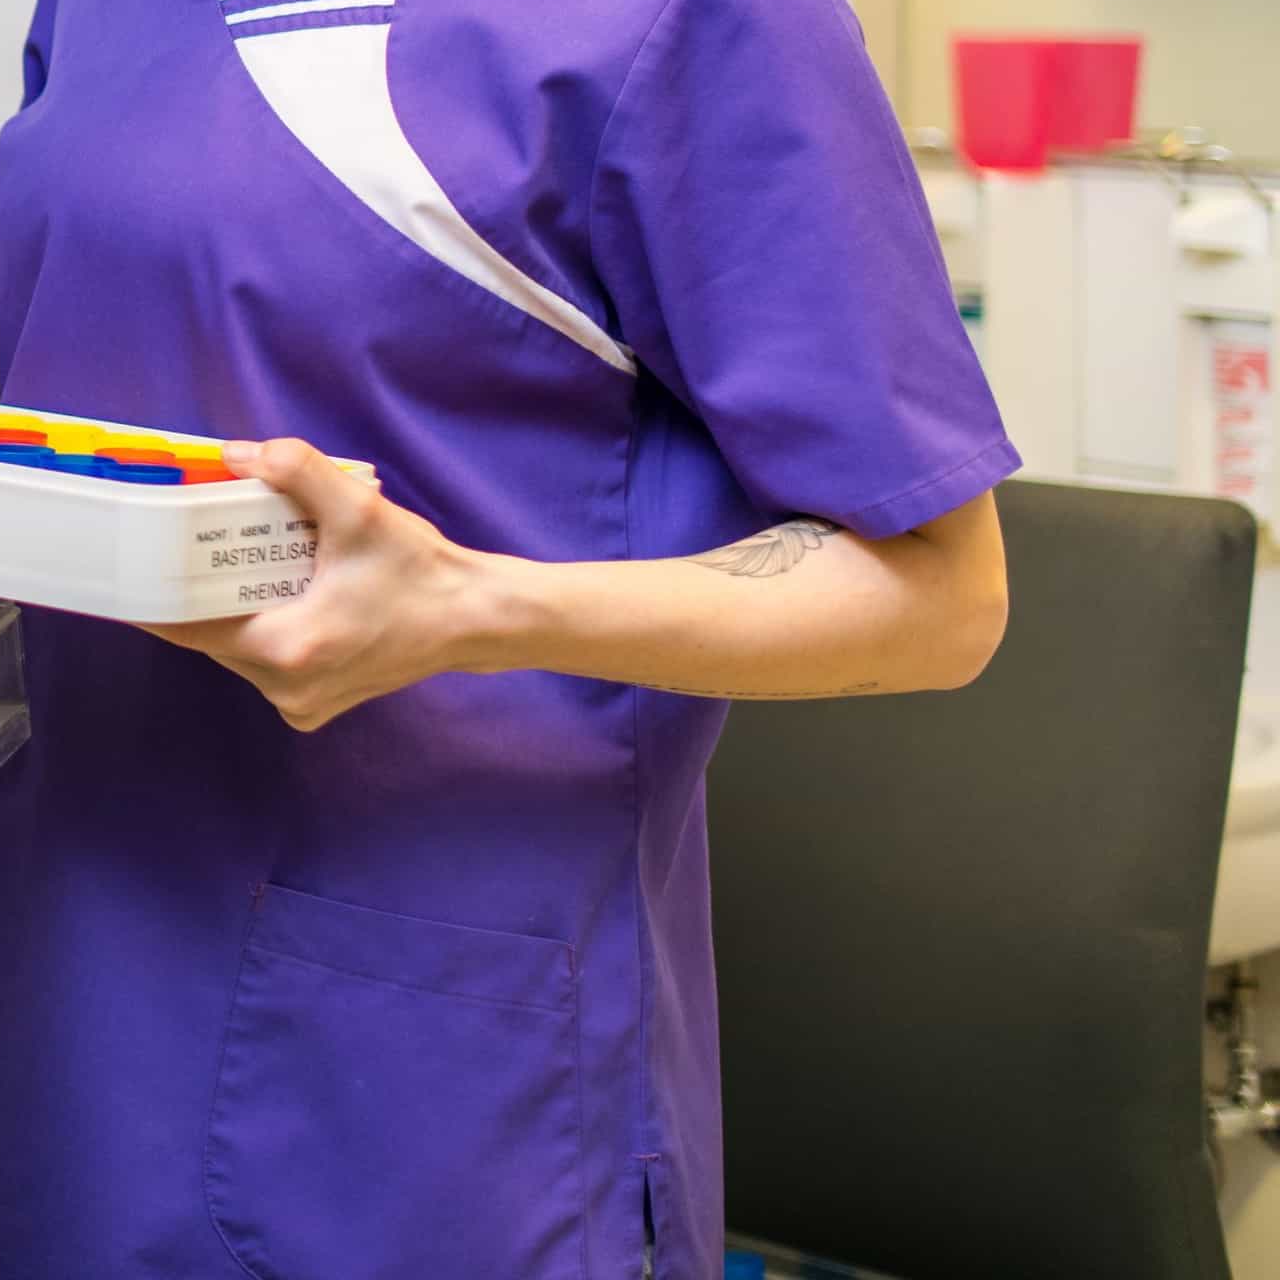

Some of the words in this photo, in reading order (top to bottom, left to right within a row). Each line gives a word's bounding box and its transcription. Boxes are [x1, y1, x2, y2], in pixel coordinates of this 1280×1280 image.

[197, 529, 227, 541] NACHT
[240, 524, 271, 537] ABEND
[211, 547, 265, 567] BASTEN
[238, 577, 312, 601] RHEINBLIC
